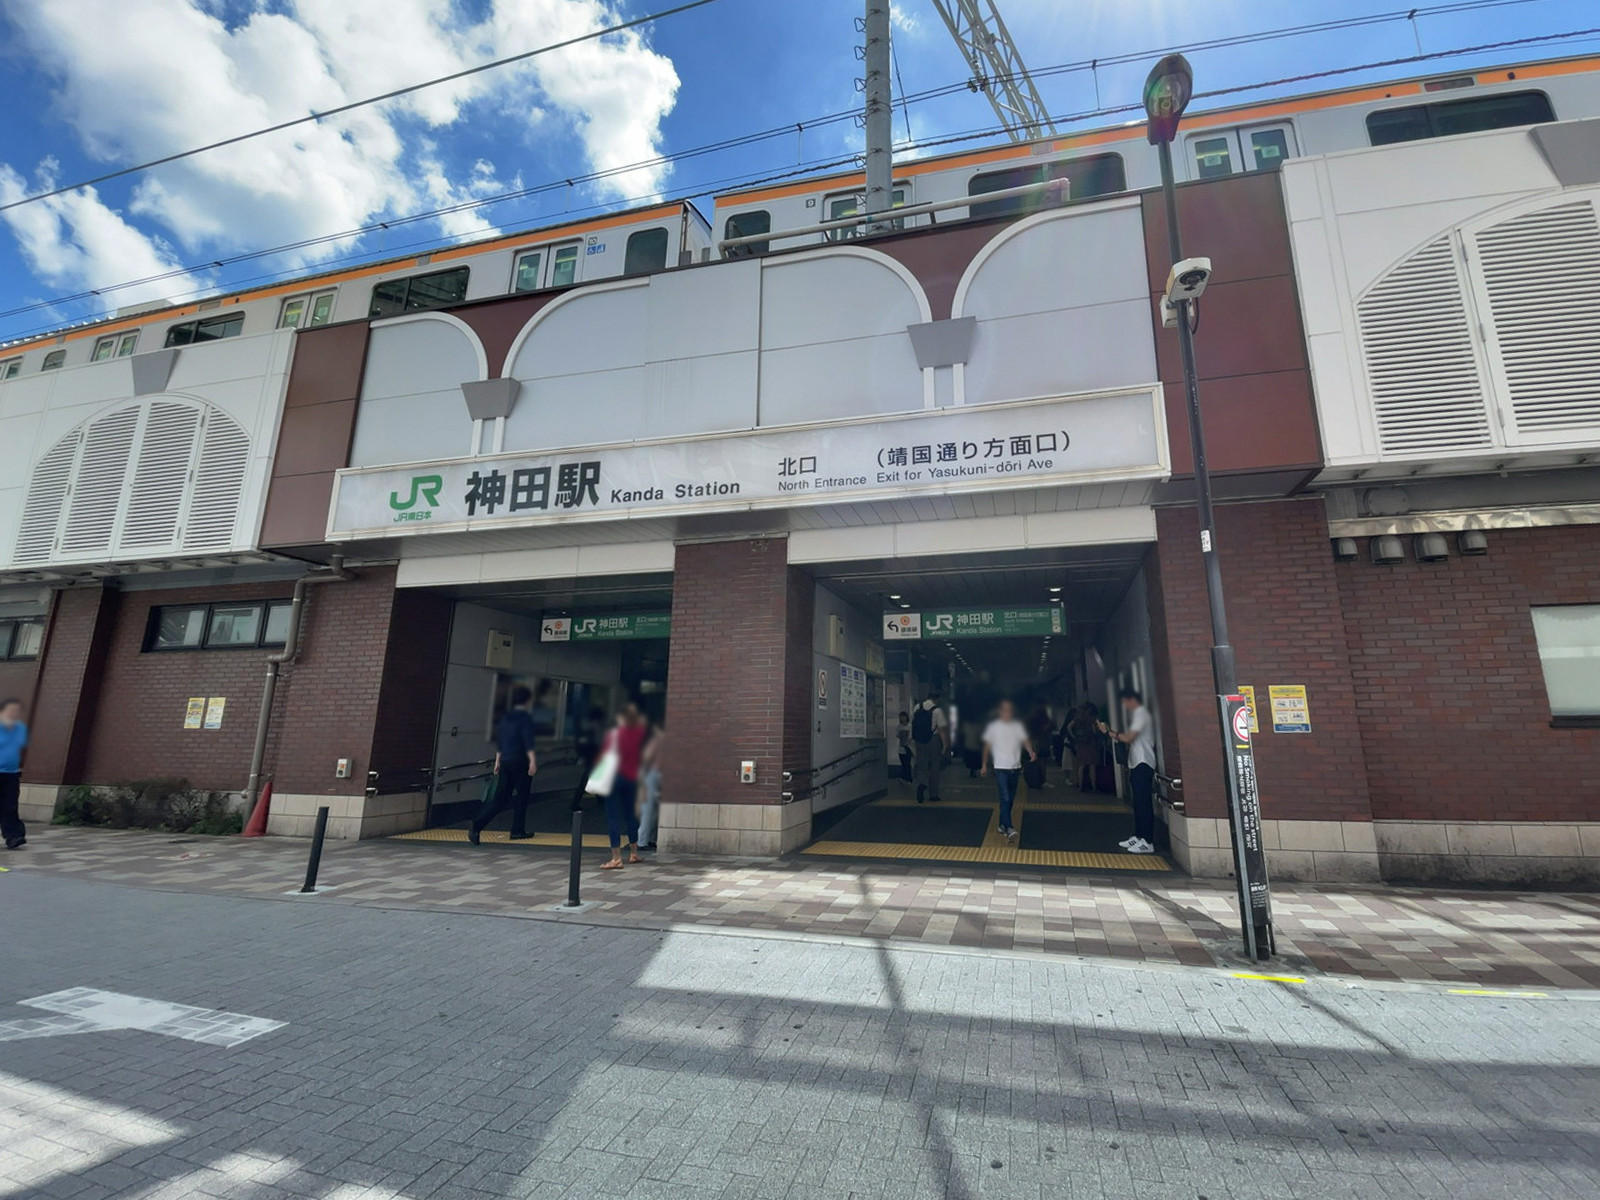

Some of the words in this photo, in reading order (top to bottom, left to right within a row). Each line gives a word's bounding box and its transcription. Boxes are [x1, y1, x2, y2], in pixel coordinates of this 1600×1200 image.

[777, 456, 818, 477] 北口
[876, 470, 900, 484] Exit
[904, 468, 922, 481] for
[928, 461, 1023, 479] Yasukuni-dōri
[1026, 458, 1053, 471] Ave
[464, 460, 602, 516] 神田駅
[778, 479, 810, 491] North
[814, 474, 867, 489] Entrance
[389, 474, 443, 510] JR
[610, 486, 664, 504] Kanda
[675, 480, 741, 499] Station
[574, 619, 597, 633] JR
[599, 617, 628, 630] 神田駅
[925, 614, 954, 630] JR
[956, 612, 995, 626] 神田駅
[956, 627, 978, 635] Kanda
[979, 626, 1002, 634] Station
[1243, 755, 1249, 766] No
[1244, 768, 1254, 801] Smoking
